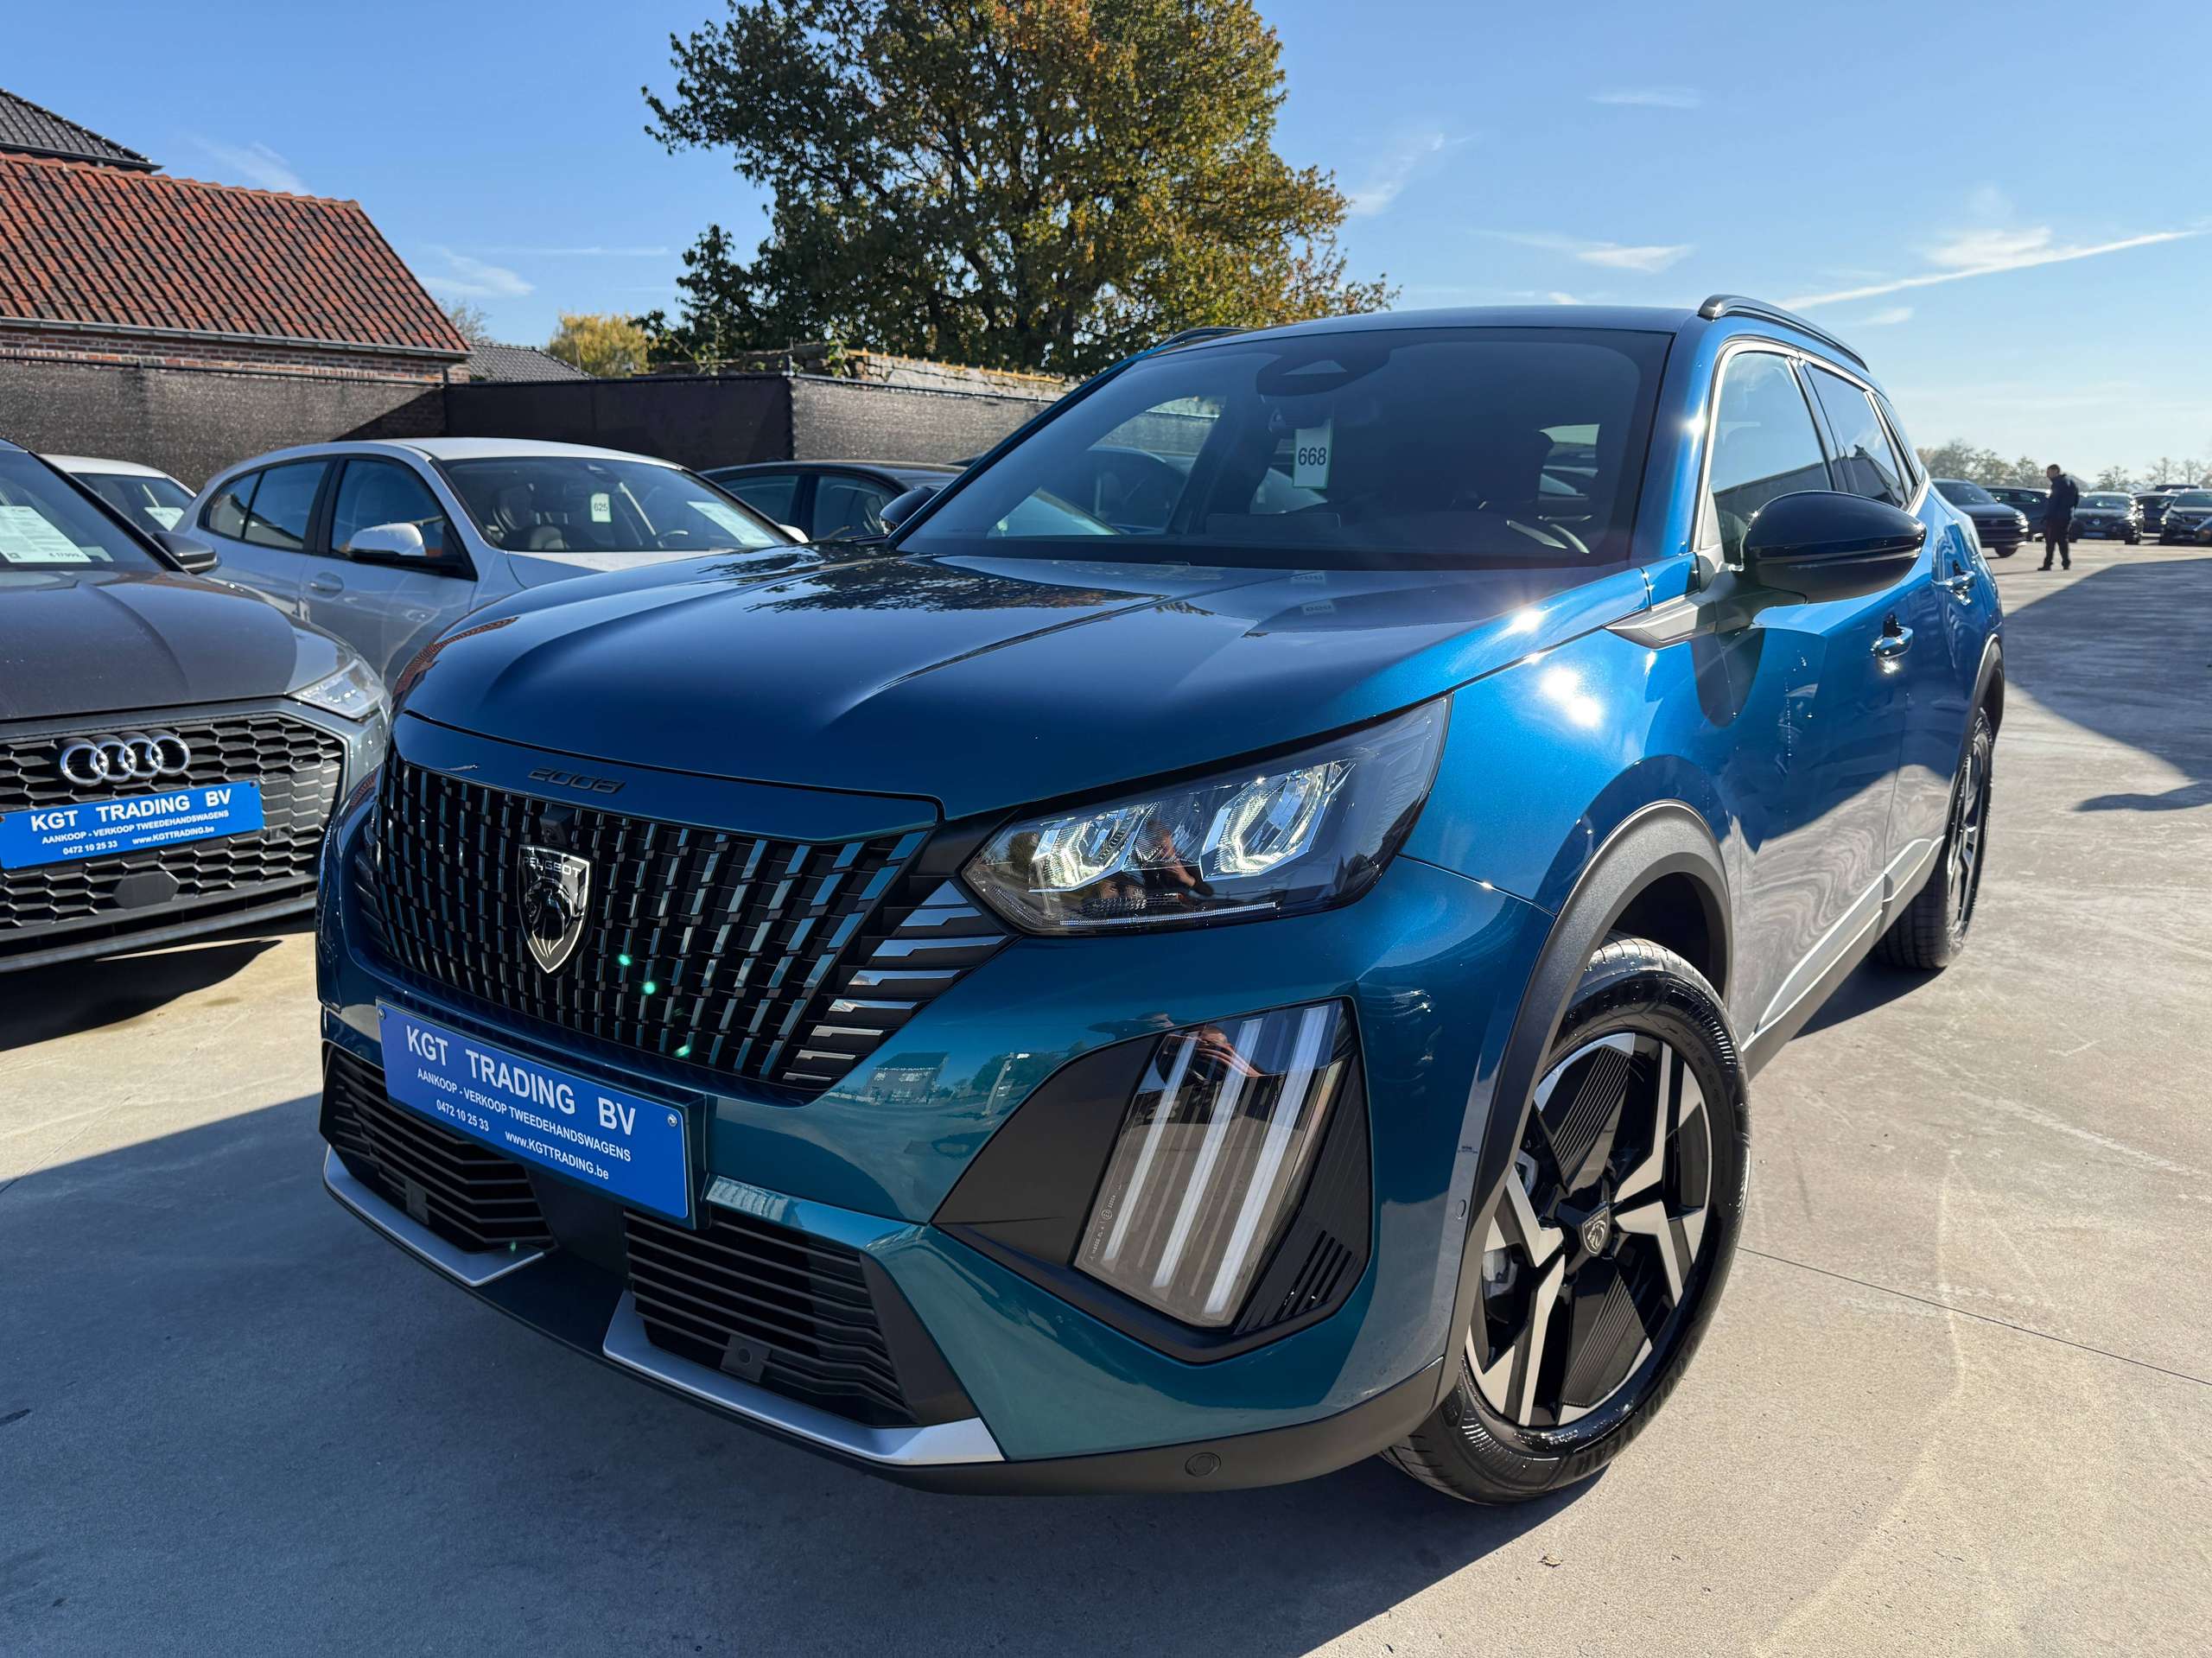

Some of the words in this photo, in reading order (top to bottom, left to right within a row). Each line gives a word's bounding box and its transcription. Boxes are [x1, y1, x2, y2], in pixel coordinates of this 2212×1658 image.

[1299, 447, 1327, 466] 668
[527, 767, 626, 794] 2008
[30, 810, 79, 831] KGT
[95, 795, 190, 823] TRADING
[205, 788, 232, 807] BV
[41, 831, 86, 844] AANKOOP
[92, 824, 135, 837] VERKOOP
[136, 810, 229, 830] TWEEDEHANDSWAGENS
[132, 826, 215, 845] www.KGTTRADING.be
[62, 846, 84, 855] 0472
[85, 843, 95, 852] 10
[96, 842, 106, 850] 25
[107, 840, 118, 848] 33
[523, 857, 582, 878] PEUGEOT
[406, 1025, 448, 1066] KGT
[465, 1049, 575, 1115] TRADING
[598, 1096, 636, 1135] BV
[417, 1068, 458, 1093] AANKOOP
[463, 1087, 507, 1114] VERKOOP
[509, 1106, 632, 1162] TWEEDEHANDSWAGENS
[436, 1099, 455, 1116] 0472
[456, 1109, 467, 1121] 10
[467, 1113, 478, 1127] 25
[479, 1118, 490, 1132] 33
[505, 1131, 609, 1179] www.KGTTRADING.be
